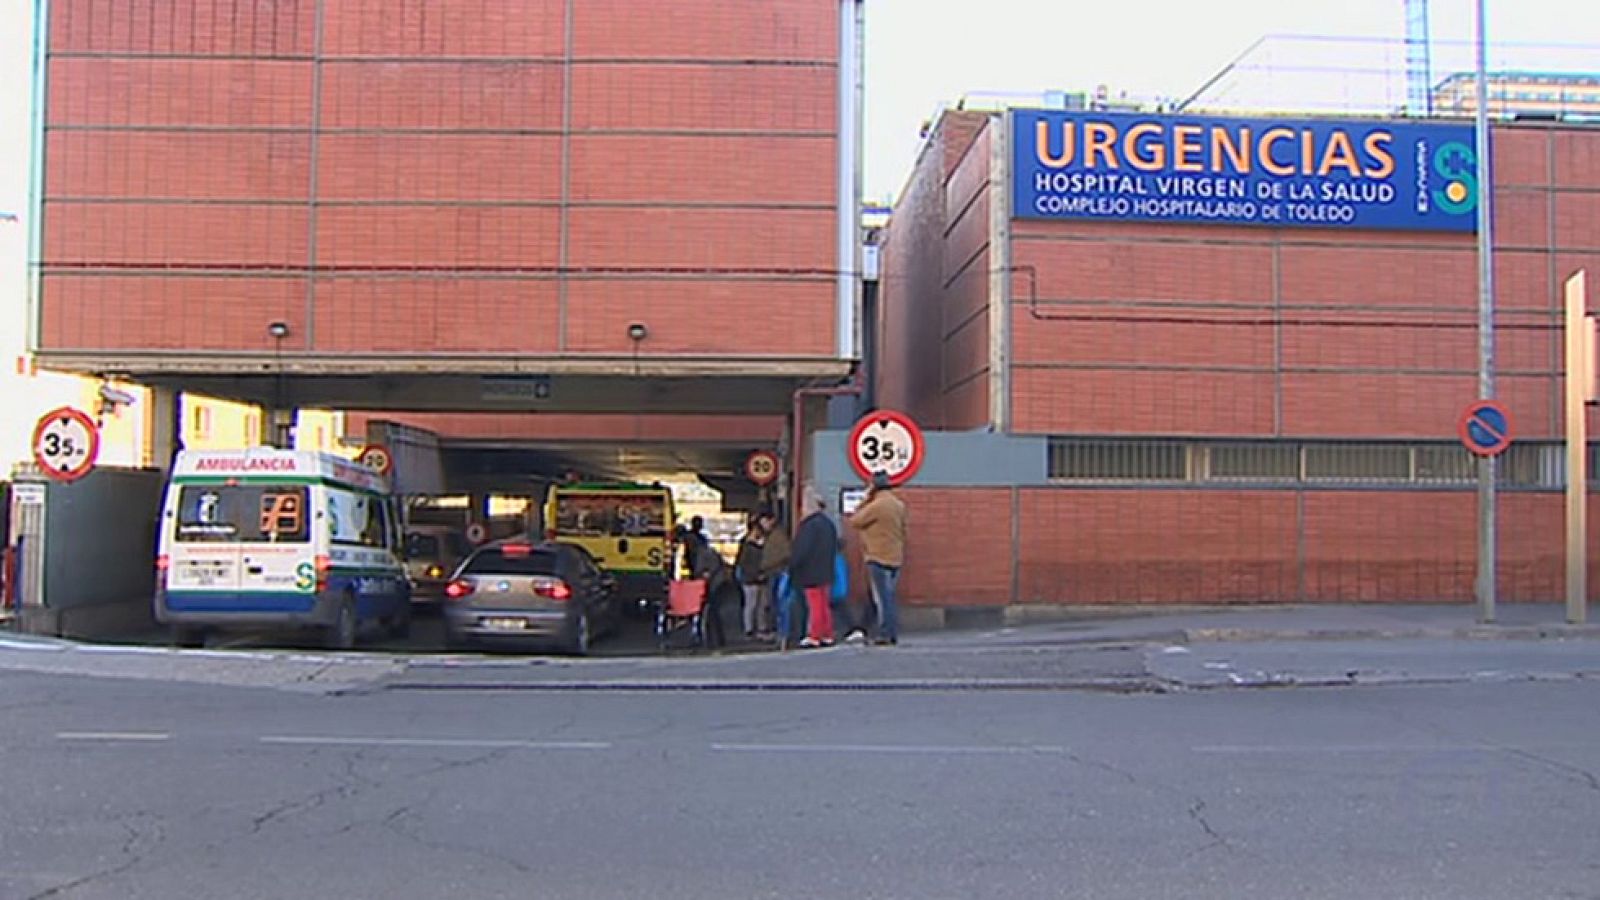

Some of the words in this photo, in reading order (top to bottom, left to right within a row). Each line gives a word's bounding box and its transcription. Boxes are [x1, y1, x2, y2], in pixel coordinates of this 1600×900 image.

[1036, 121, 1395, 178] URGENCIAS
[1035, 172, 1147, 194] HOSPITAL
[1155, 176, 1245, 197] VIRGEN
[1257, 181, 1283, 199] DE
[1289, 182, 1315, 200] LA
[1321, 182, 1394, 202] SALUD
[1035, 195, 1129, 215] COMPLEJO
[1134, 198, 1257, 219] HOSPITALARIO
[1261, 203, 1281, 220] DE
[1287, 203, 1355, 222] TOLEDO
[195, 458, 296, 471] AMBULANCIA
